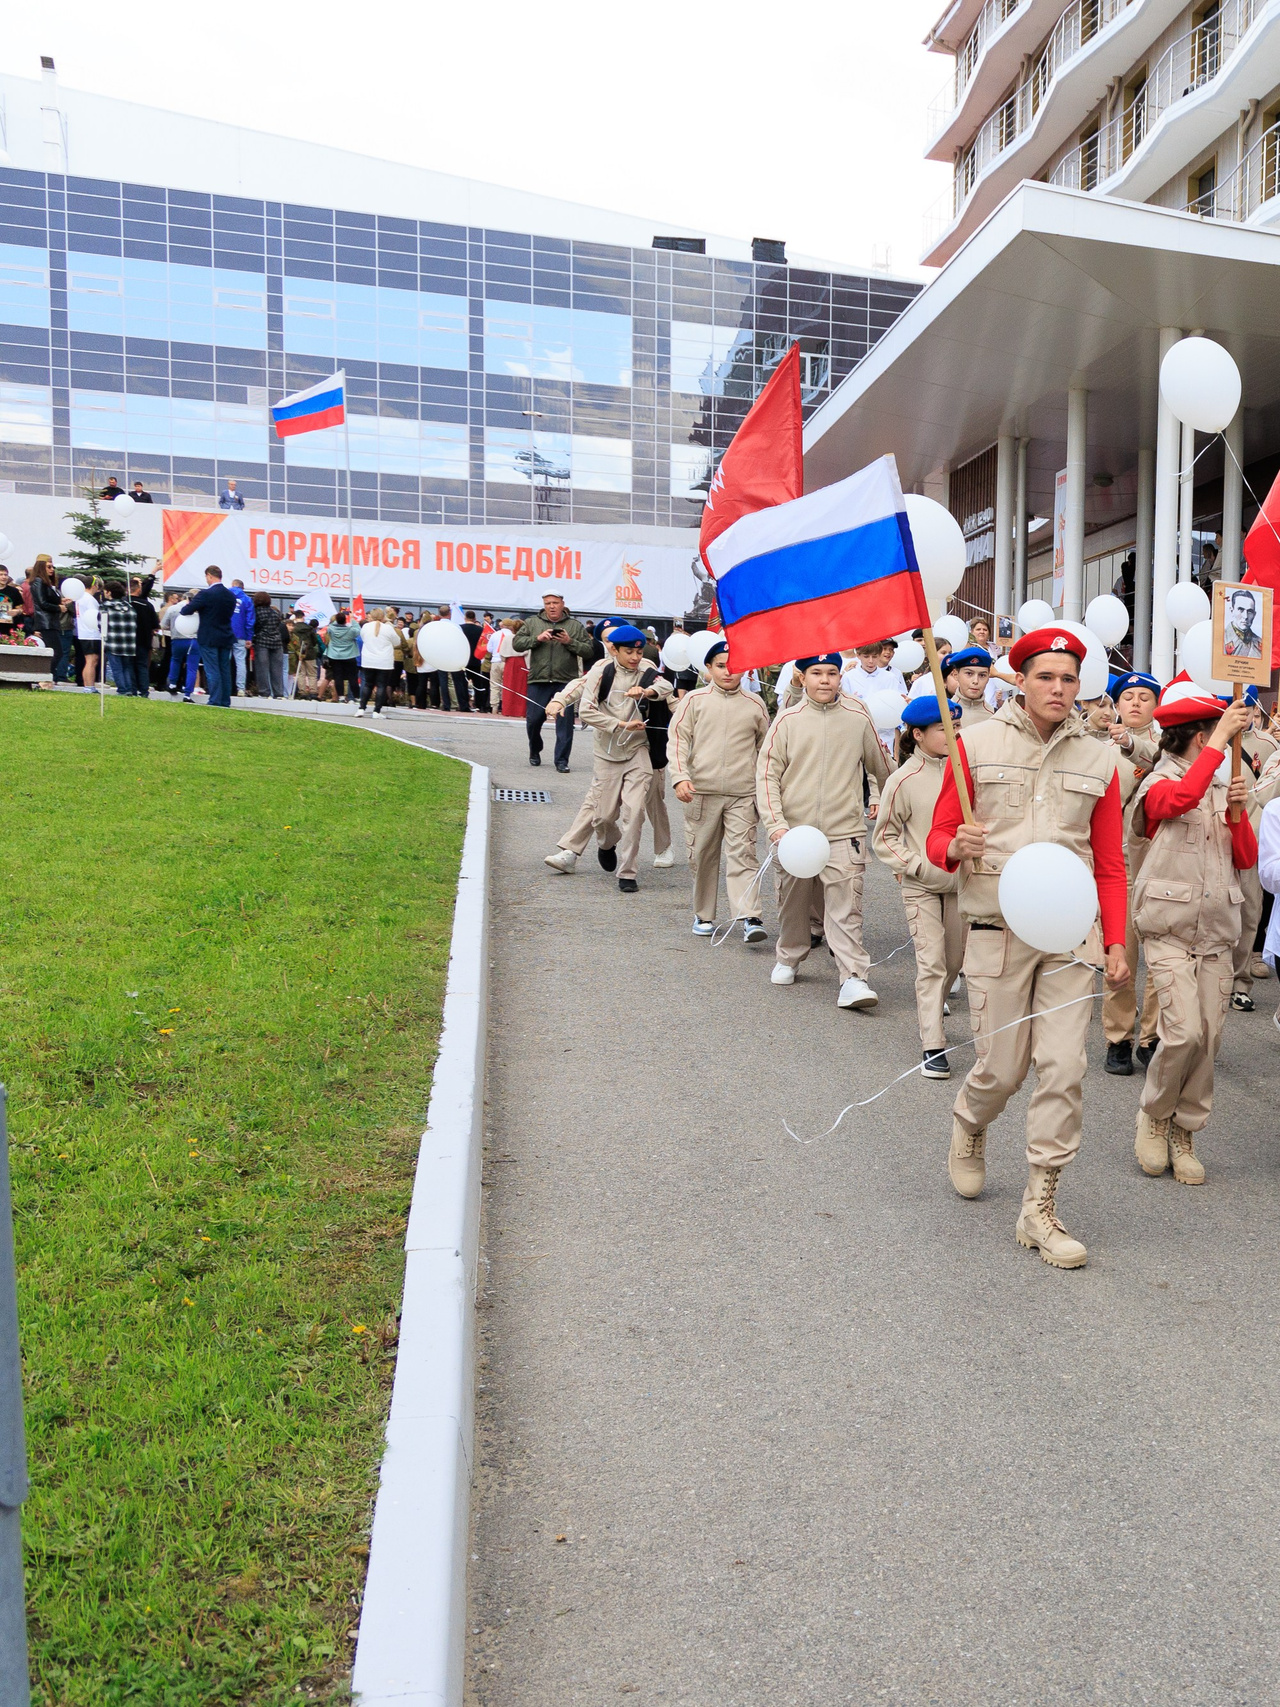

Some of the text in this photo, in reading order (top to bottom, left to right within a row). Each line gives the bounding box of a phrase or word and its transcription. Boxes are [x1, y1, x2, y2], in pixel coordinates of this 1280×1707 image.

[249, 528, 582, 582] ГОРДИМСЯ ПОБЕДОЙ!
[615, 585, 631, 600] 80
